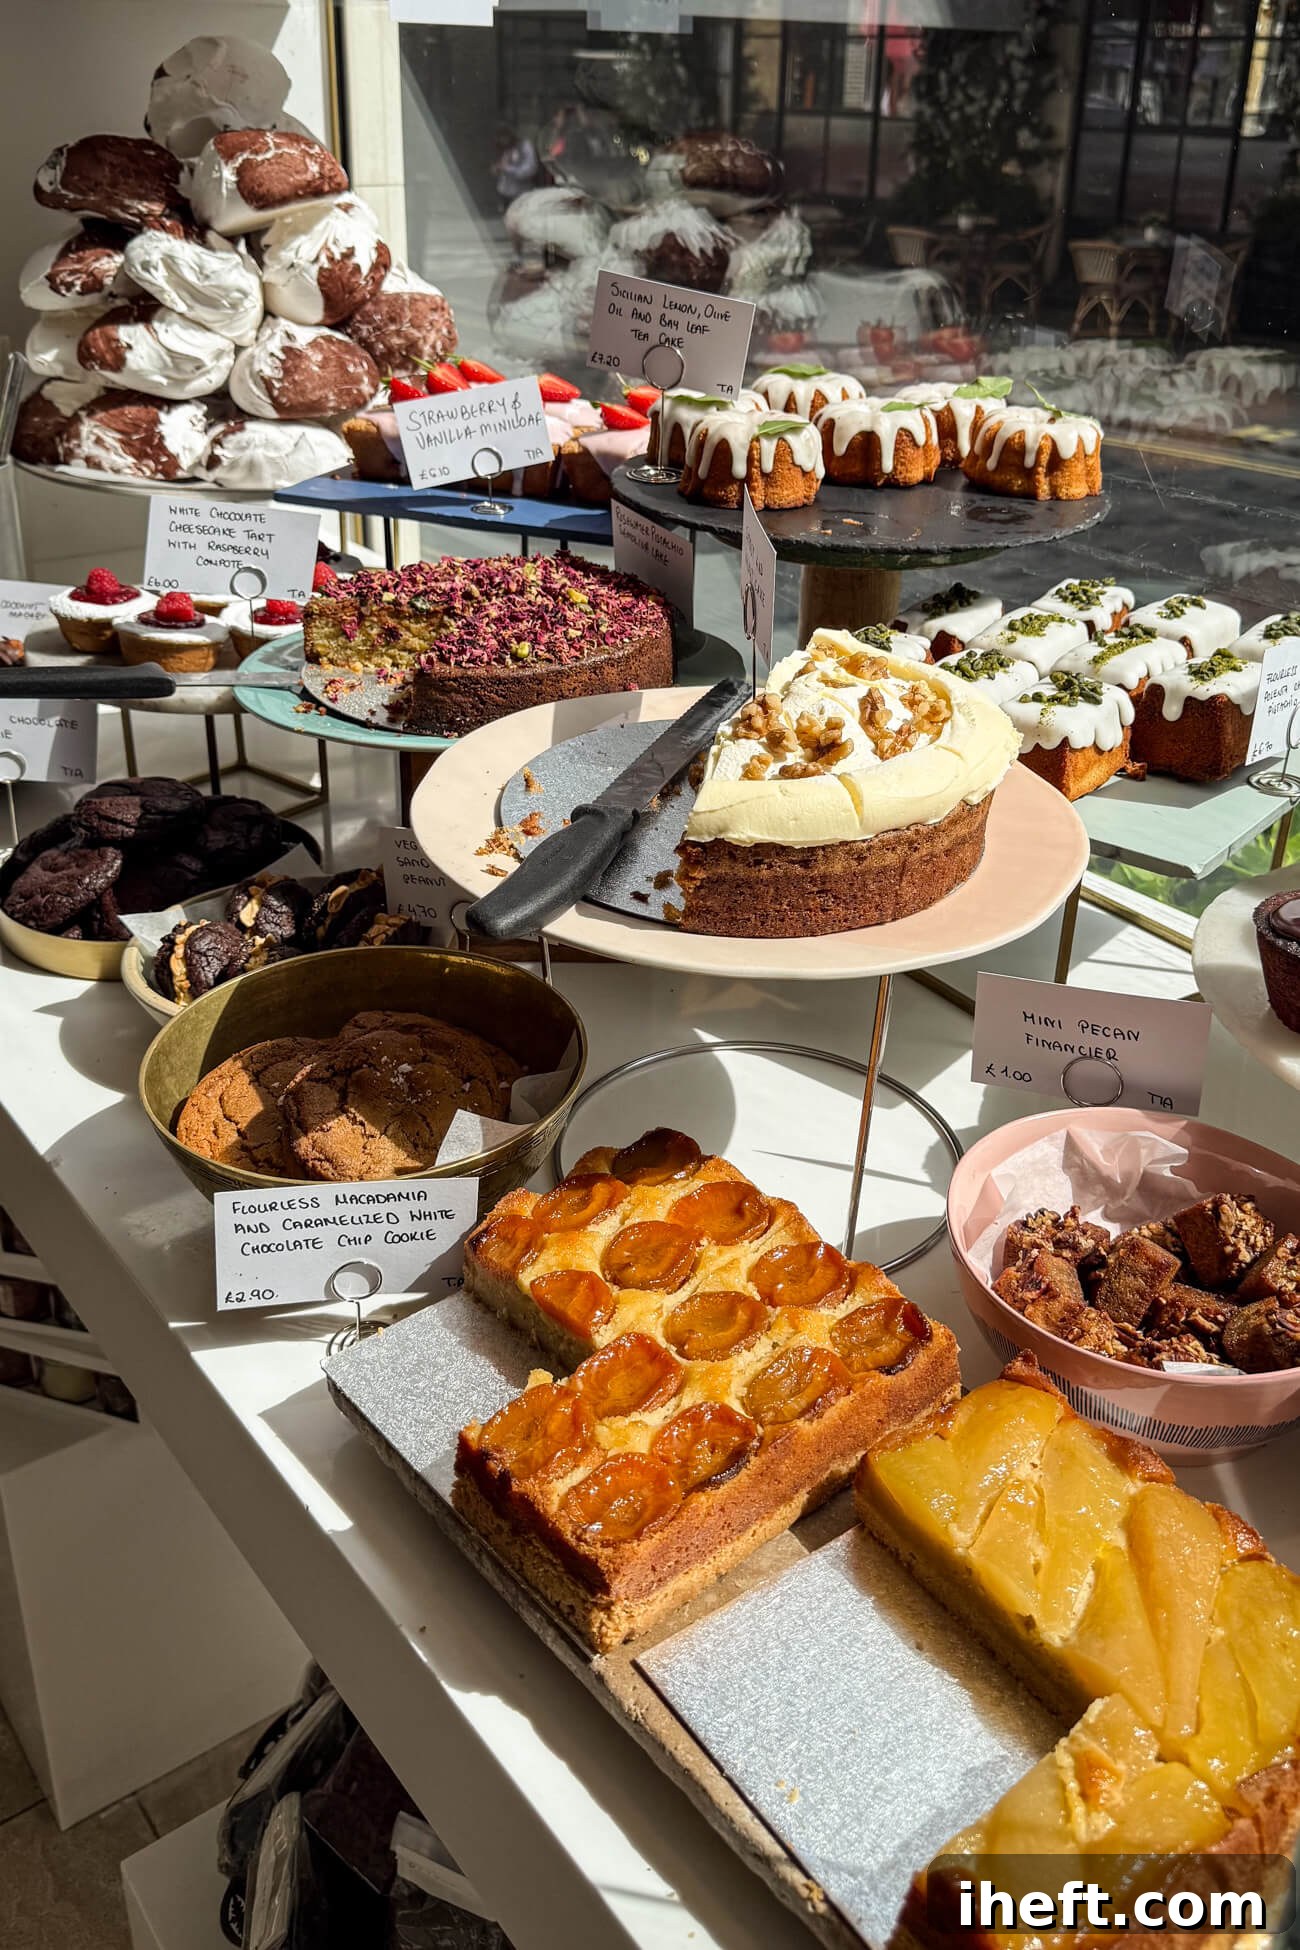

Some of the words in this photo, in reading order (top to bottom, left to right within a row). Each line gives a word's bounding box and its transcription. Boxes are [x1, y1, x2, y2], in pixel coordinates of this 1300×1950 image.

[611, 282, 653, 305] SICILIAN
[608, 302, 624, 317] OIL
[631, 309, 652, 324] AND
[659, 313, 679, 331] BAY
[686, 323, 711, 335] LEAF
[630, 329, 650, 342] TEA
[658, 332, 685, 349] CAKE
[406, 398, 508, 433] STRAWBERRY
[169, 505, 201, 518] WHITE
[210, 506, 267, 524] CHOCOLATE
[169, 521, 237, 539] CHEESECAKE
[243, 529, 276, 544] TART
[168, 539, 197, 551] WITH
[208, 541, 270, 560] RASPBERRY
[196, 556, 244, 569] COMPOTE
[9, 715, 79, 730] CHOCOLATE
[394, 839, 418, 851] VEG
[396, 856, 430, 869] SAND
[403, 873, 447, 888] PEANUT
[1022, 1010, 1062, 1030] MINI
[1078, 1019, 1141, 1042] PECAN
[1024, 1032, 1119, 1062] FINANCIER
[232, 1196, 321, 1215] FLOURLESS
[335, 1189, 428, 1206] MACADAMIA
[234, 1222, 271, 1235] AND
[282, 1211, 400, 1232] CARAMELIZED
[409, 1208, 456, 1223] WHITE
[241, 1236, 324, 1257] CHOCOLATE
[338, 1233, 373, 1248] CHIP
[384, 1228, 437, 1245] COOKIE
